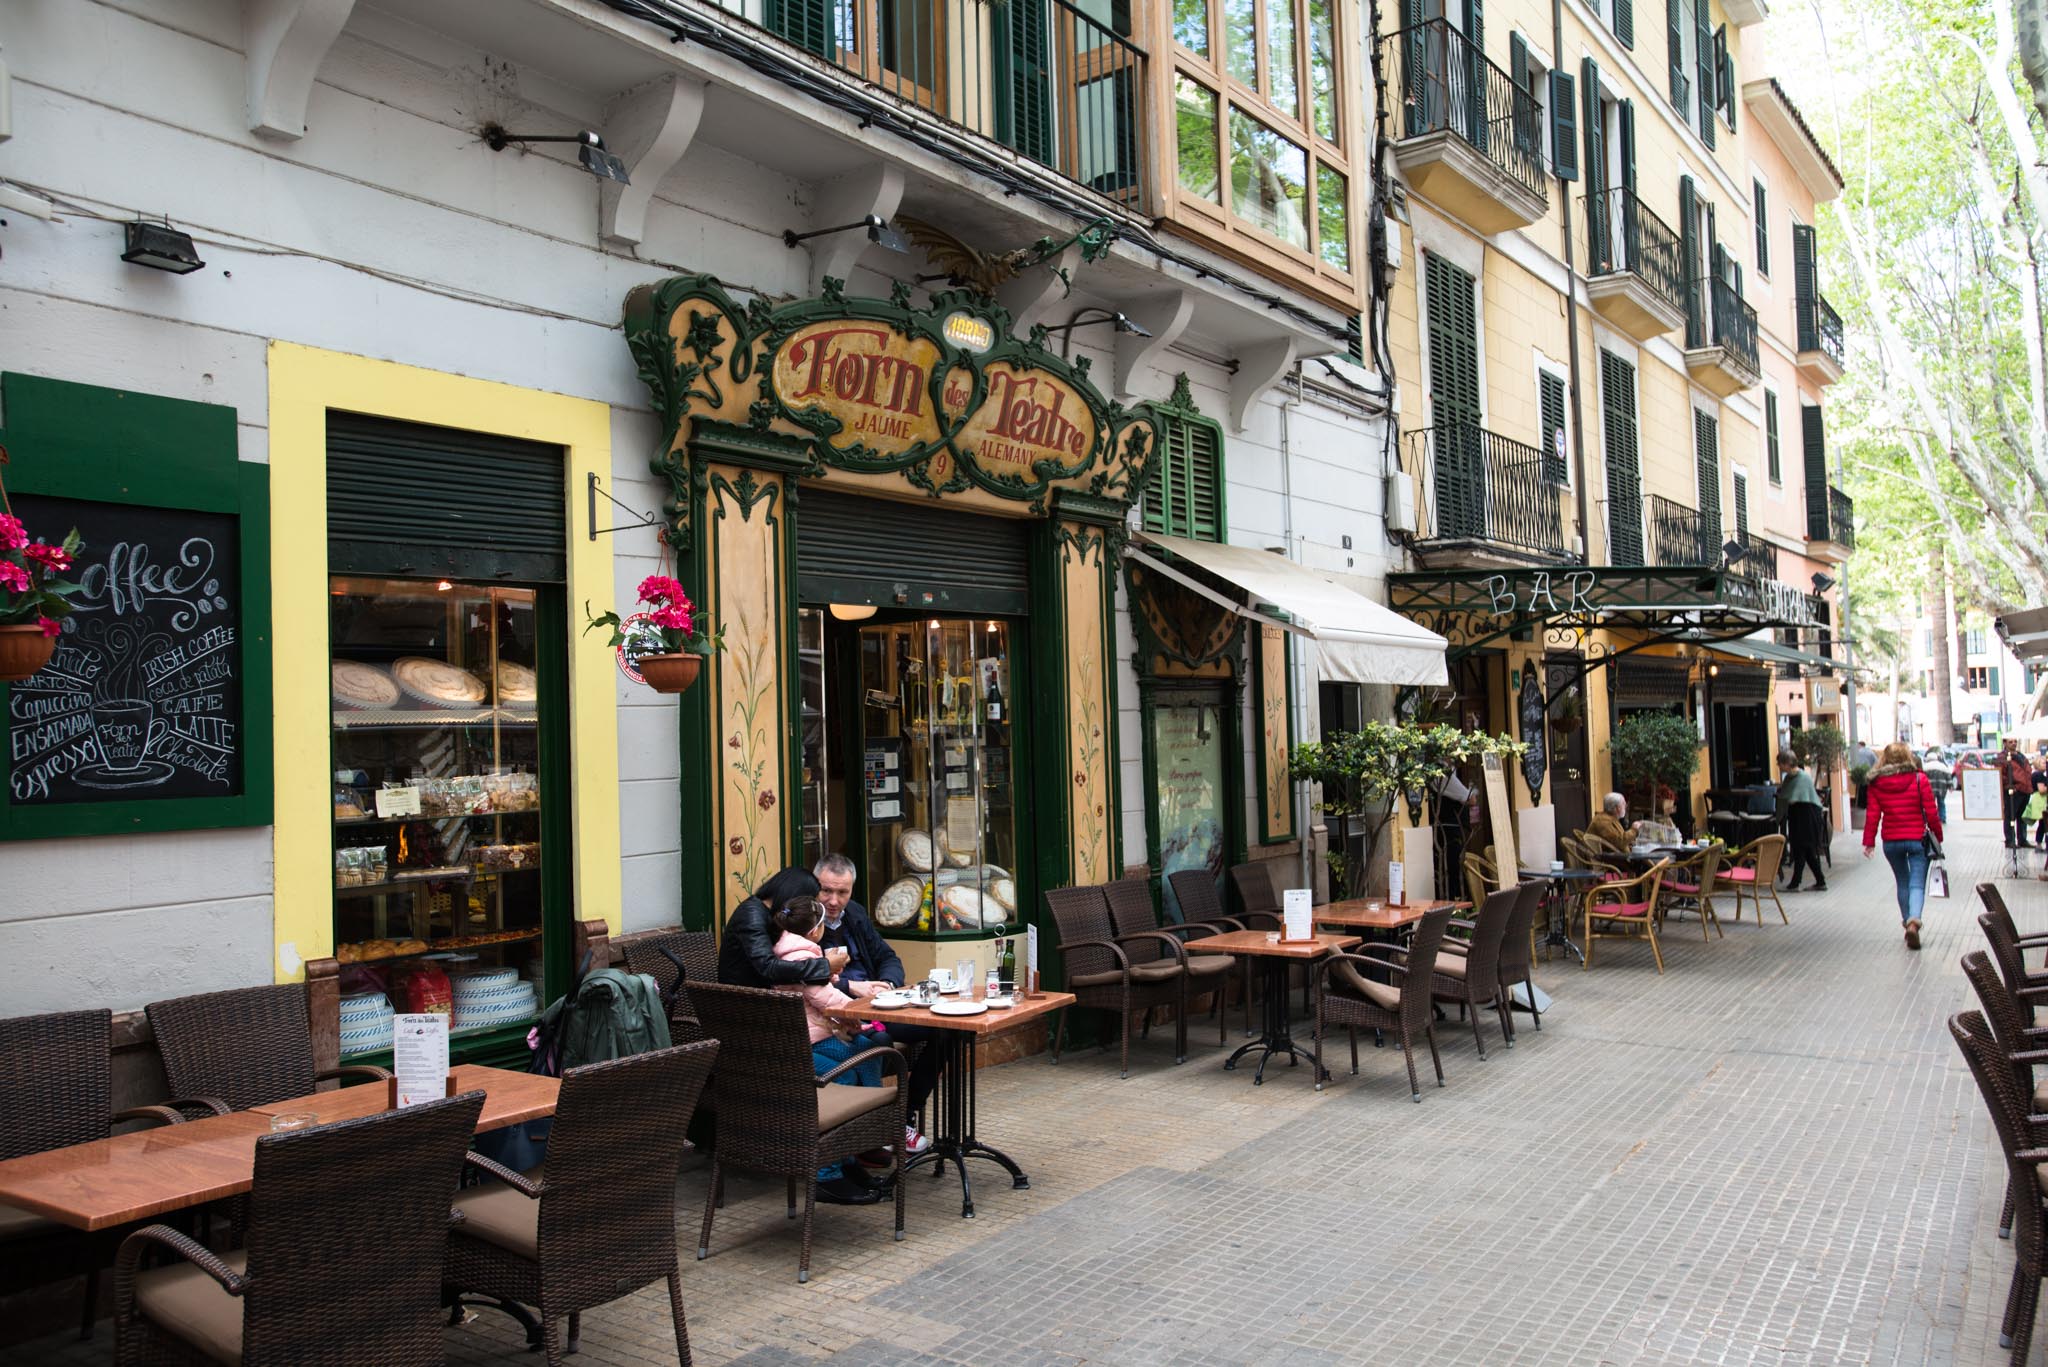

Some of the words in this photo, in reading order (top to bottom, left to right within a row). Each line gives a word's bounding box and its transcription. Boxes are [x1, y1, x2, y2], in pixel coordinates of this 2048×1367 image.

[946, 316, 990, 348] HORNO
[789, 327, 923, 418] Forn
[944, 379, 970, 409] des
[986, 369, 1087, 460] Teatre
[854, 411, 913, 441] JAUME
[935, 454, 947, 475] 9
[976, 438, 1038, 466] ALEMANY
[1481, 570, 1602, 617] BAR
[140, 645, 188, 684] IRISH
[188, 625, 236, 657] COFFEE
[617, 650, 643, 682] VIGILANCIA
[149, 680, 179, 702] coca
[161, 693, 223, 714] CAFE
[9, 692, 92, 726] Capuccino
[12, 712, 93, 761] ENSAIMADA
[98, 719, 143, 740] Forn
[115, 734, 132, 744] des
[173, 715, 235, 750] LATTE
[10, 735, 97, 800] Espresso
[102, 742, 141, 760] Teatre
[156, 735, 230, 788] Chocolate
